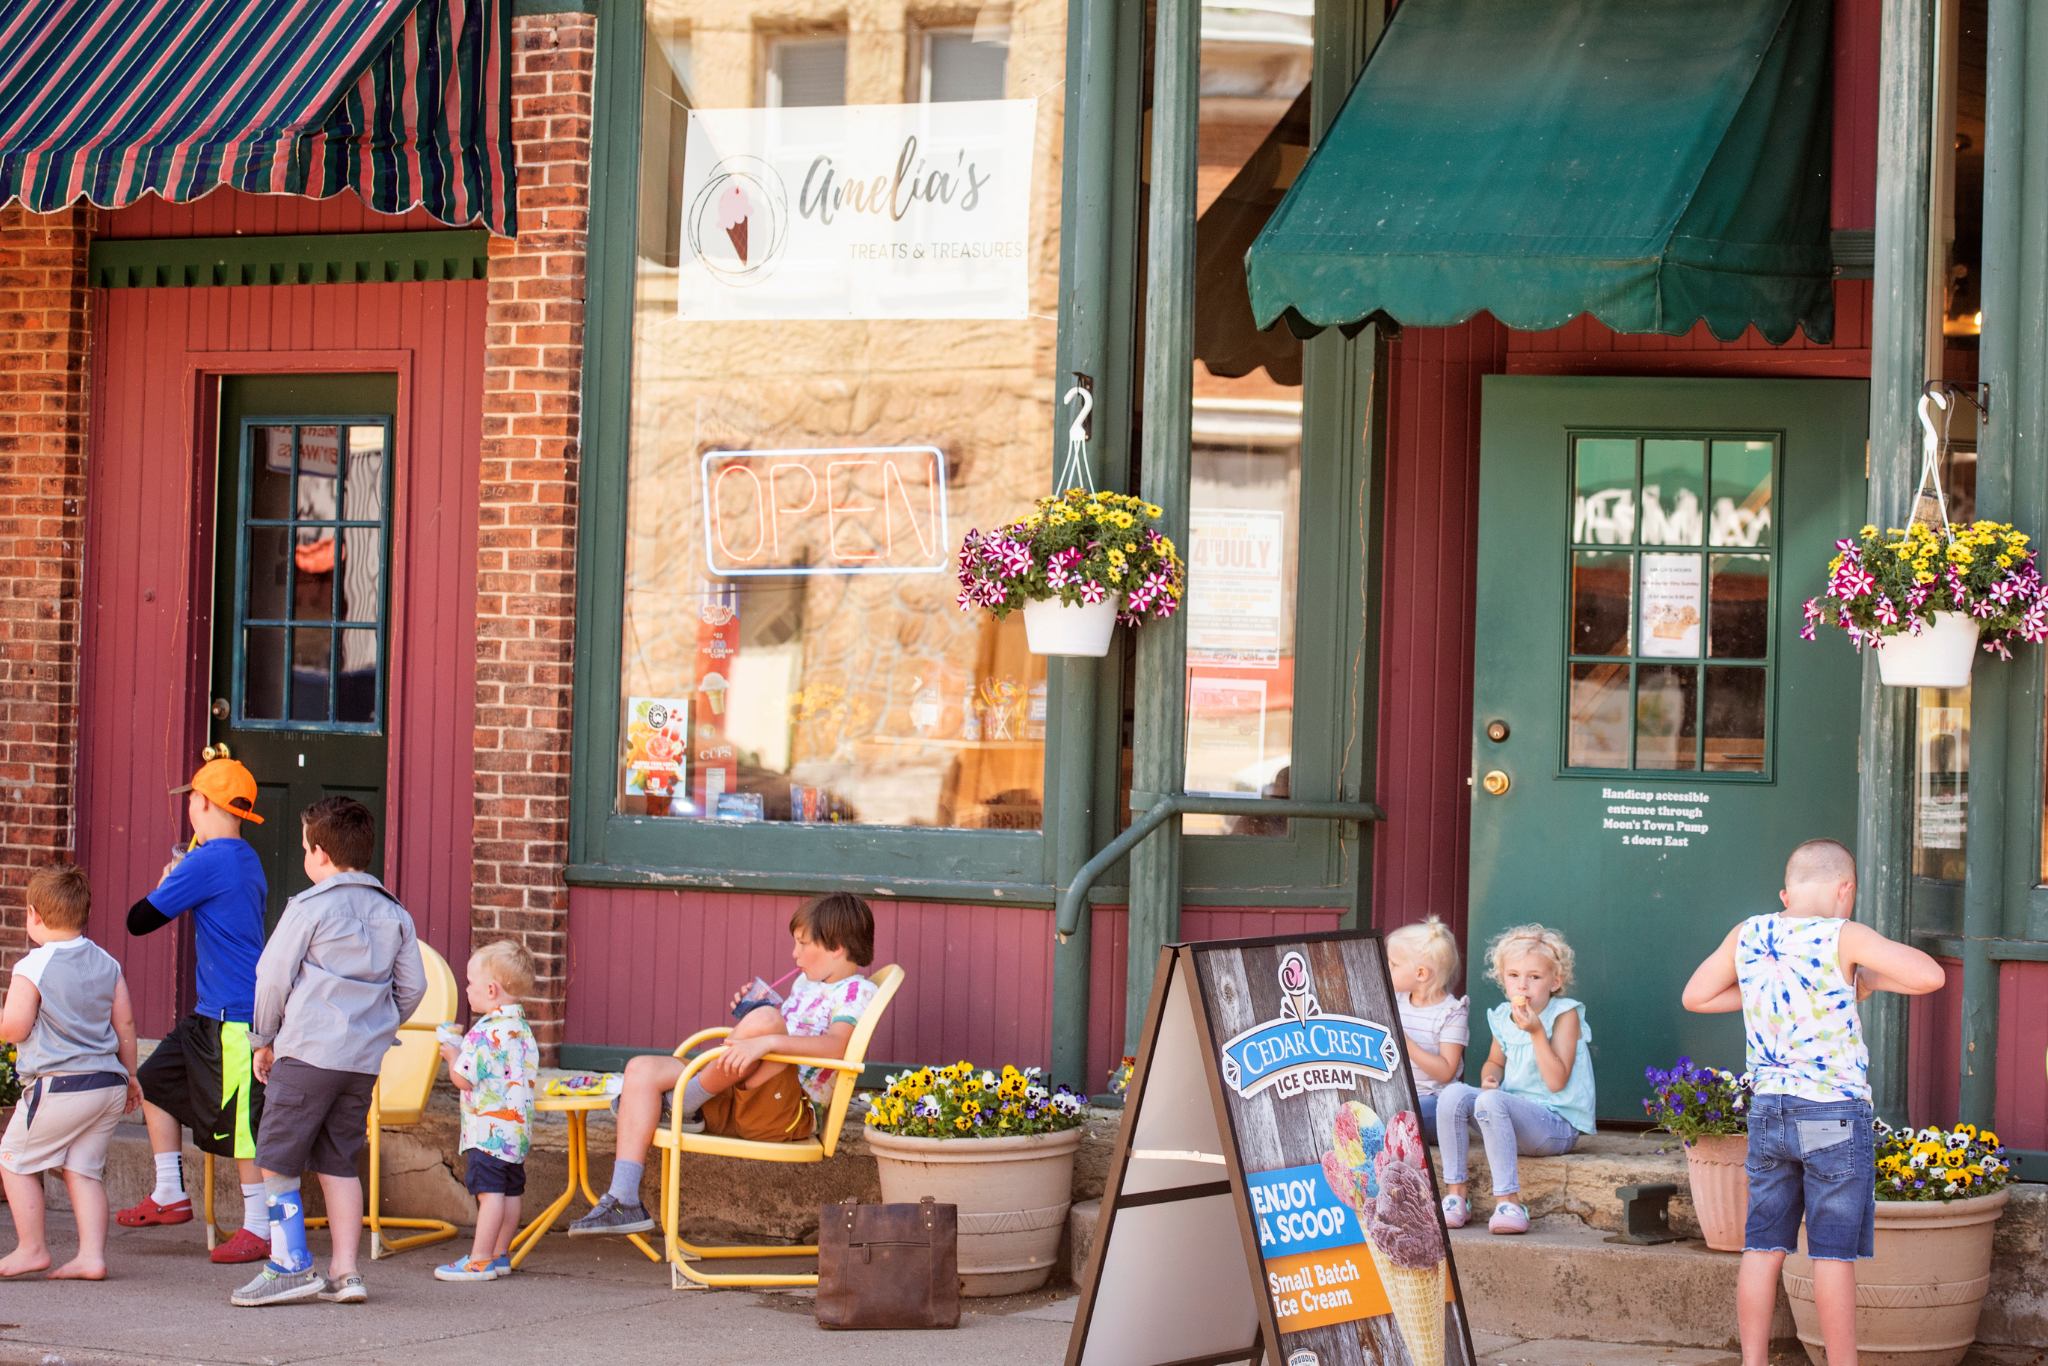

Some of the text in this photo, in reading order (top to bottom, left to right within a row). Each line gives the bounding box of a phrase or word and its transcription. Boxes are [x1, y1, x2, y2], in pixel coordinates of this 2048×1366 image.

[800, 135, 991, 225] Amelia's
[850, 241, 1023, 260] TREATS & TREASURES
[714, 458, 937, 561] OPEN
[1193, 526, 1228, 538] OLDEN
[1216, 540, 1272, 569] JULY
[700, 749, 732, 761] CUPS
[1602, 787, 1709, 803] Handicap accessible
[1607, 803, 1703, 819] entrance through
[1603, 818, 1709, 835] Moon's Town Pump
[1622, 834, 1689, 847] 2 doors East
[1243, 1024, 1374, 1075] CEDAR CREST
[1277, 1070, 1354, 1094] ICE CREAM
[1250, 1178, 1316, 1212] ENJOY
[1261, 1206, 1345, 1247] A SCOOP
[1269, 1259, 1360, 1295] Small Batch
[1274, 1288, 1353, 1318] Ice Cream
[1291, 1354, 1316, 1366] PROUDLY
